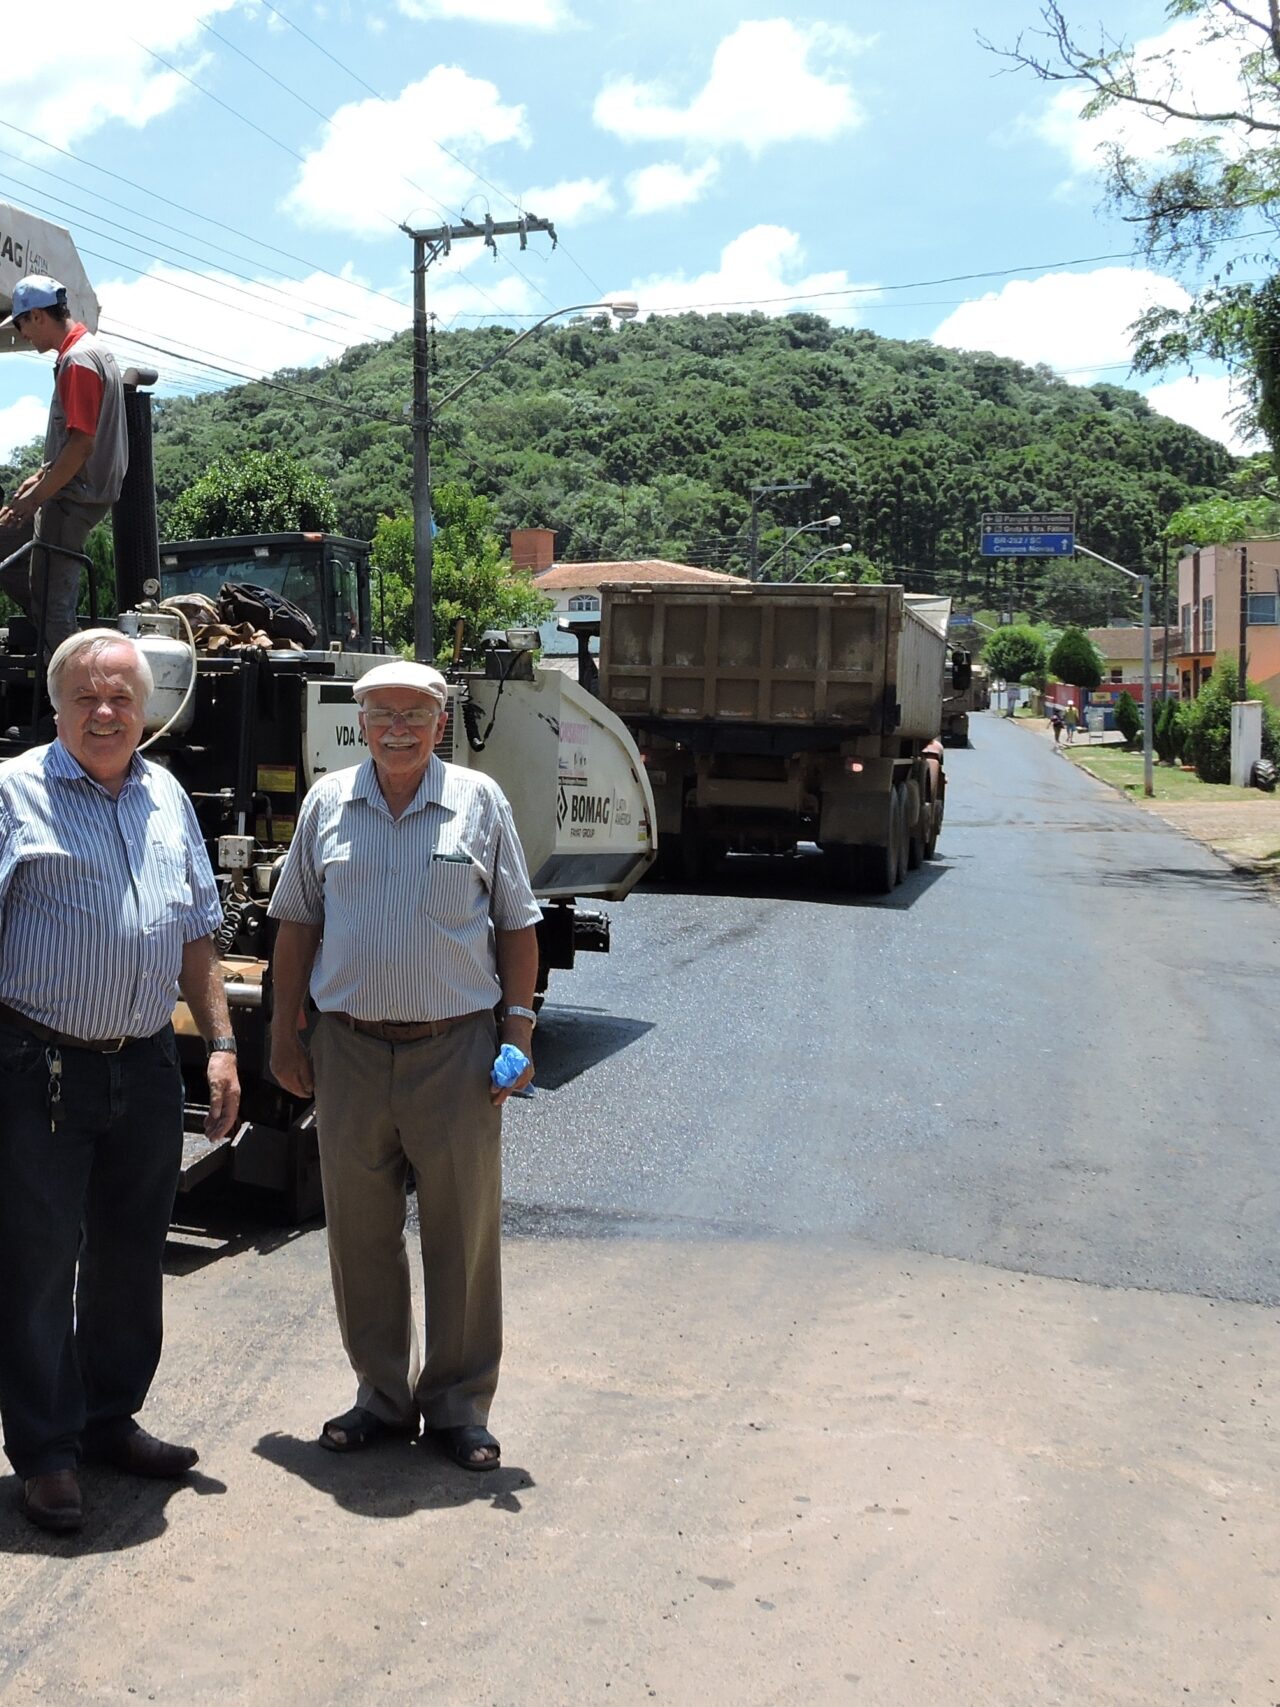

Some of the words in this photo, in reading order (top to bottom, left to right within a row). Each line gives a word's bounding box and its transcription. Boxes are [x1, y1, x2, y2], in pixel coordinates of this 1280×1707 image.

[336, 726, 355, 746] VDA
[358, 729, 368, 747] 4
[571, 795, 610, 824] BOMAG
